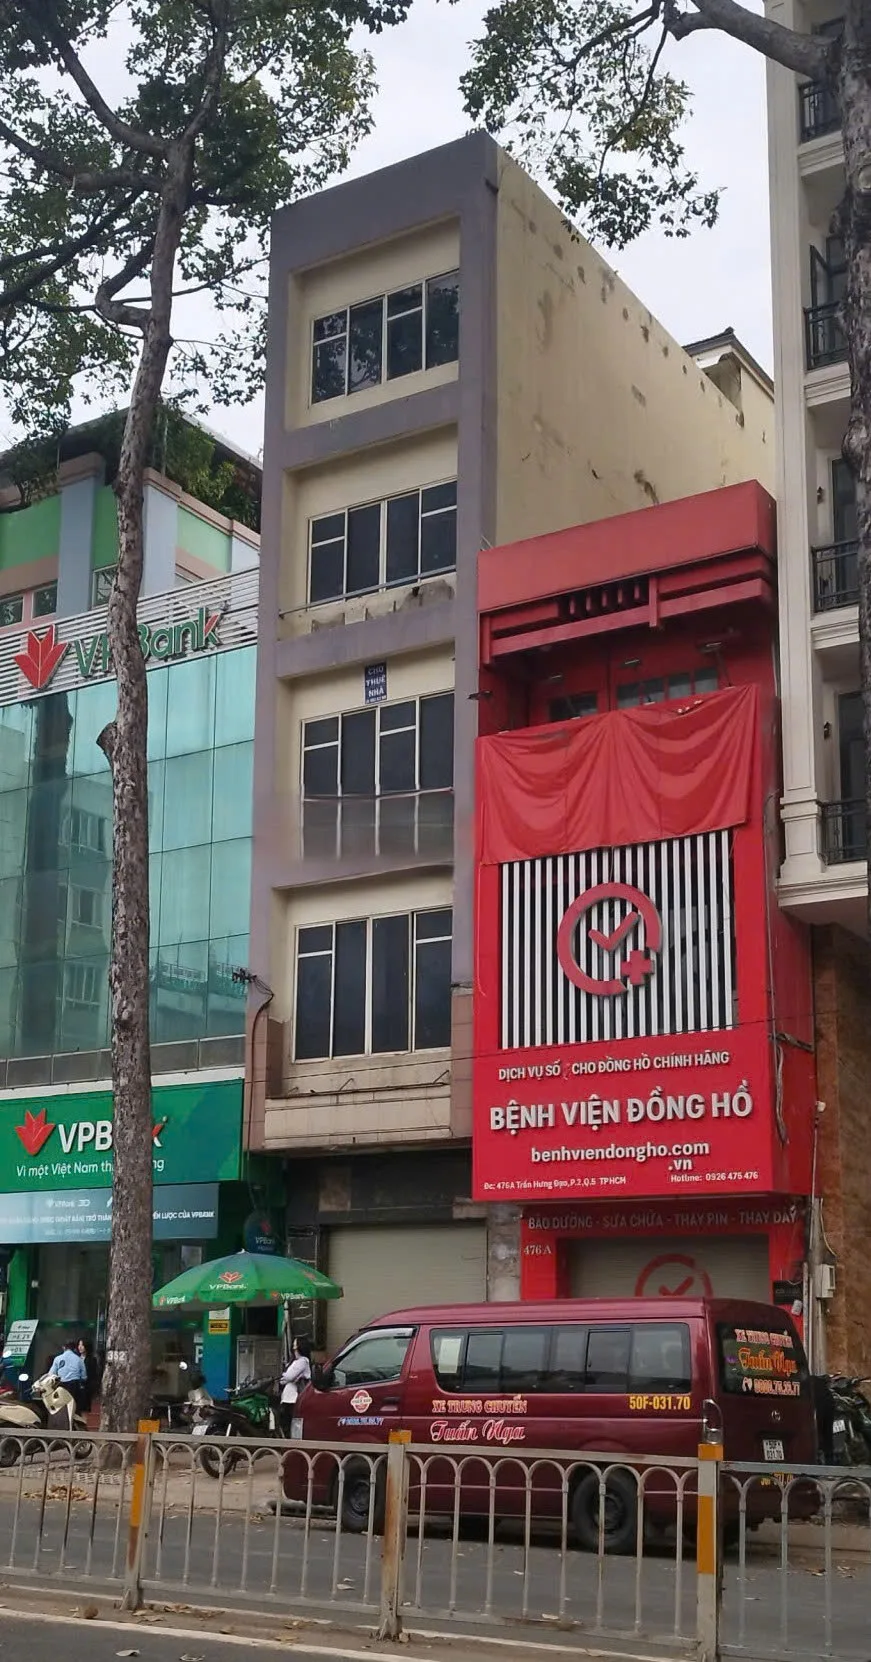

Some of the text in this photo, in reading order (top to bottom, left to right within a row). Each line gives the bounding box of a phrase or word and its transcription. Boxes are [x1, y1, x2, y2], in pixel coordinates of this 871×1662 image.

[498, 1068, 525, 1082] DỊCH
[528, 1066, 543, 1080] VỤ
[545, 1059, 561, 1076] SỐ
[571, 1061, 596, 1074] CHO
[598, 1056, 631, 1072] ĐỒNG
[634, 1053, 651, 1070] HỒ
[653, 1052, 692, 1069] CHÍNH
[694, 1049, 730, 1066] HÃNG
[490, 1079, 753, 1135] BỆNH VIỆN ĐỒNG HỒ
[531, 1141, 710, 1163] benhviendongho.com
[29, 1164, 49, 1179] một
[51, 1162, 71, 1178] Việt
[74, 1161, 98, 1174] Nam
[668, 1158, 693, 1171] .vn
[600, 1176, 626, 1185] TPHCM
[670, 1171, 758, 1183] Hotline: 0926 475 476
[432, 1400, 446, 1413] XE
[447, 1400, 482, 1413] TRUNG
[630, 1396, 690, 1410] 50F-031.70
[430, 1420, 525, 1445] Tuấn Nga
